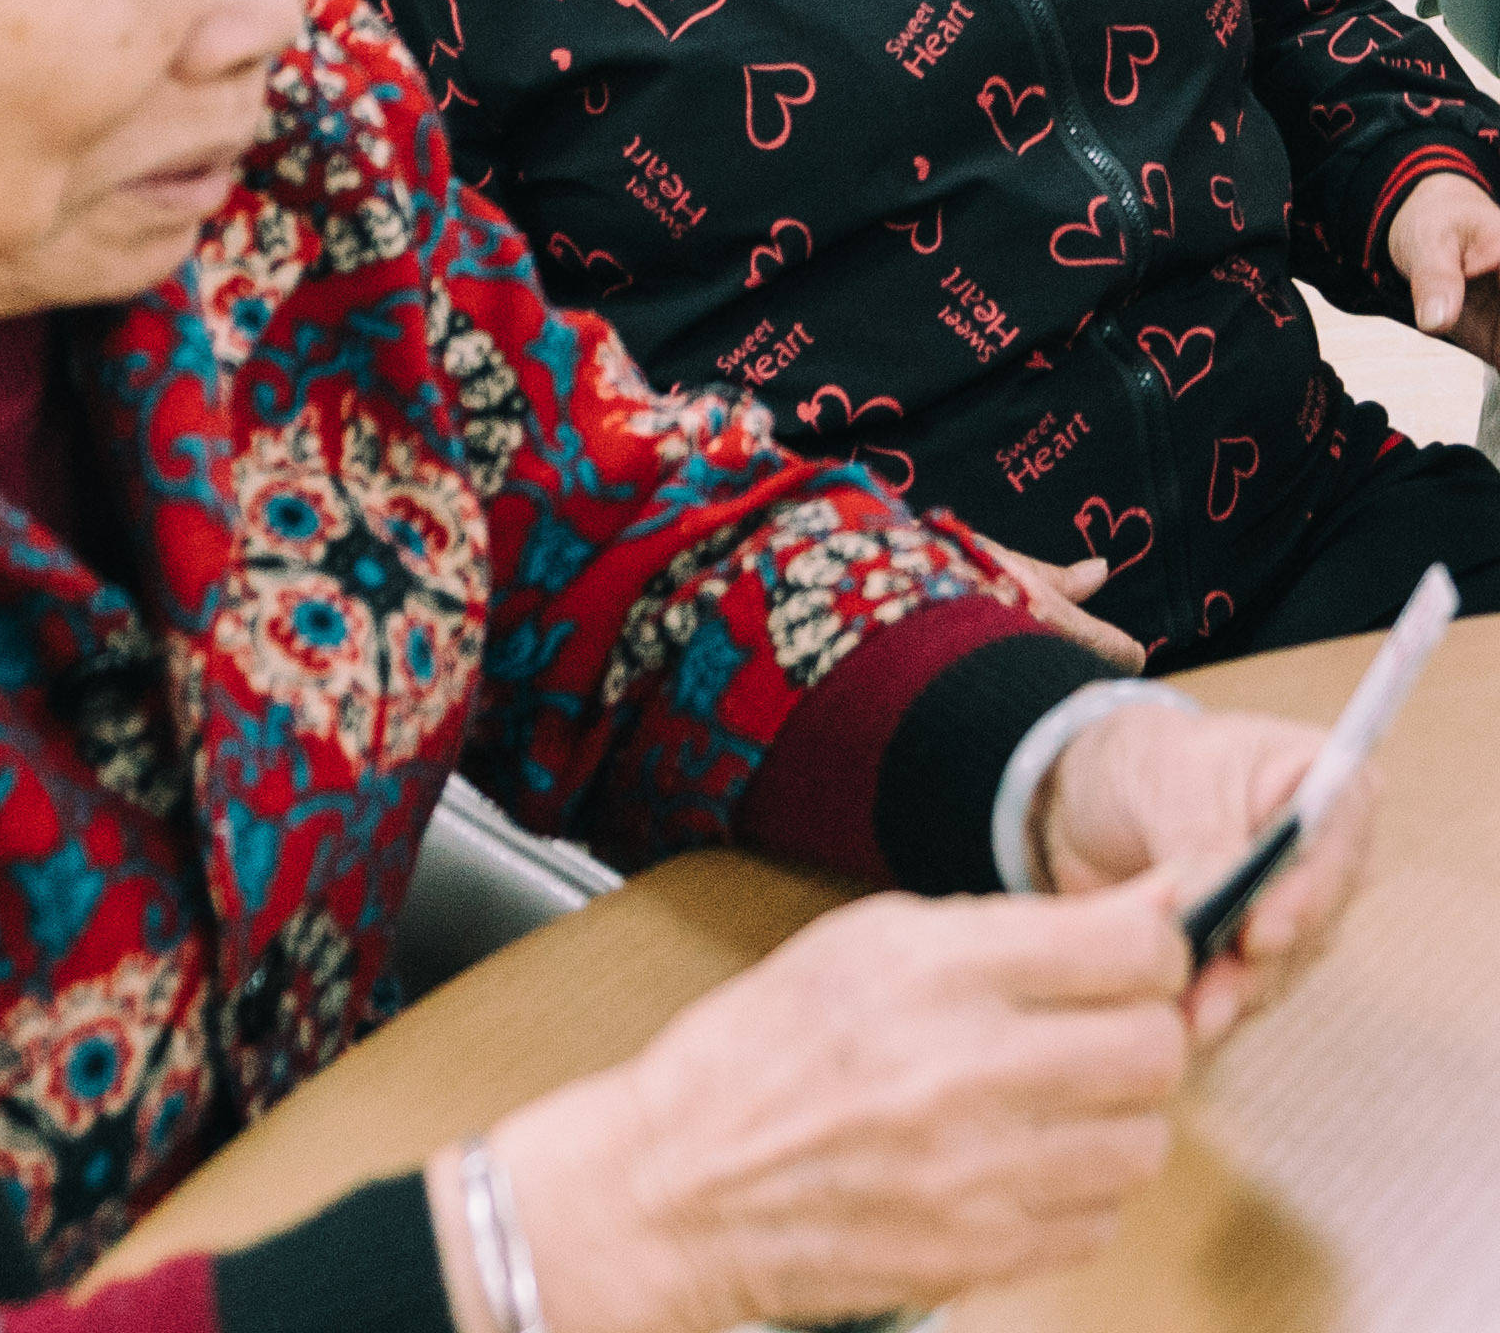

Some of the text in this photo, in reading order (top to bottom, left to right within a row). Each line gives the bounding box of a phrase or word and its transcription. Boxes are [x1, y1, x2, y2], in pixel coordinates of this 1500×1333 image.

[902, 0, 976, 79] Heart
[622, 134, 708, 224] Heart
[940, 266, 1021, 349] Heart
[1007, 412, 1091, 494] Heart
